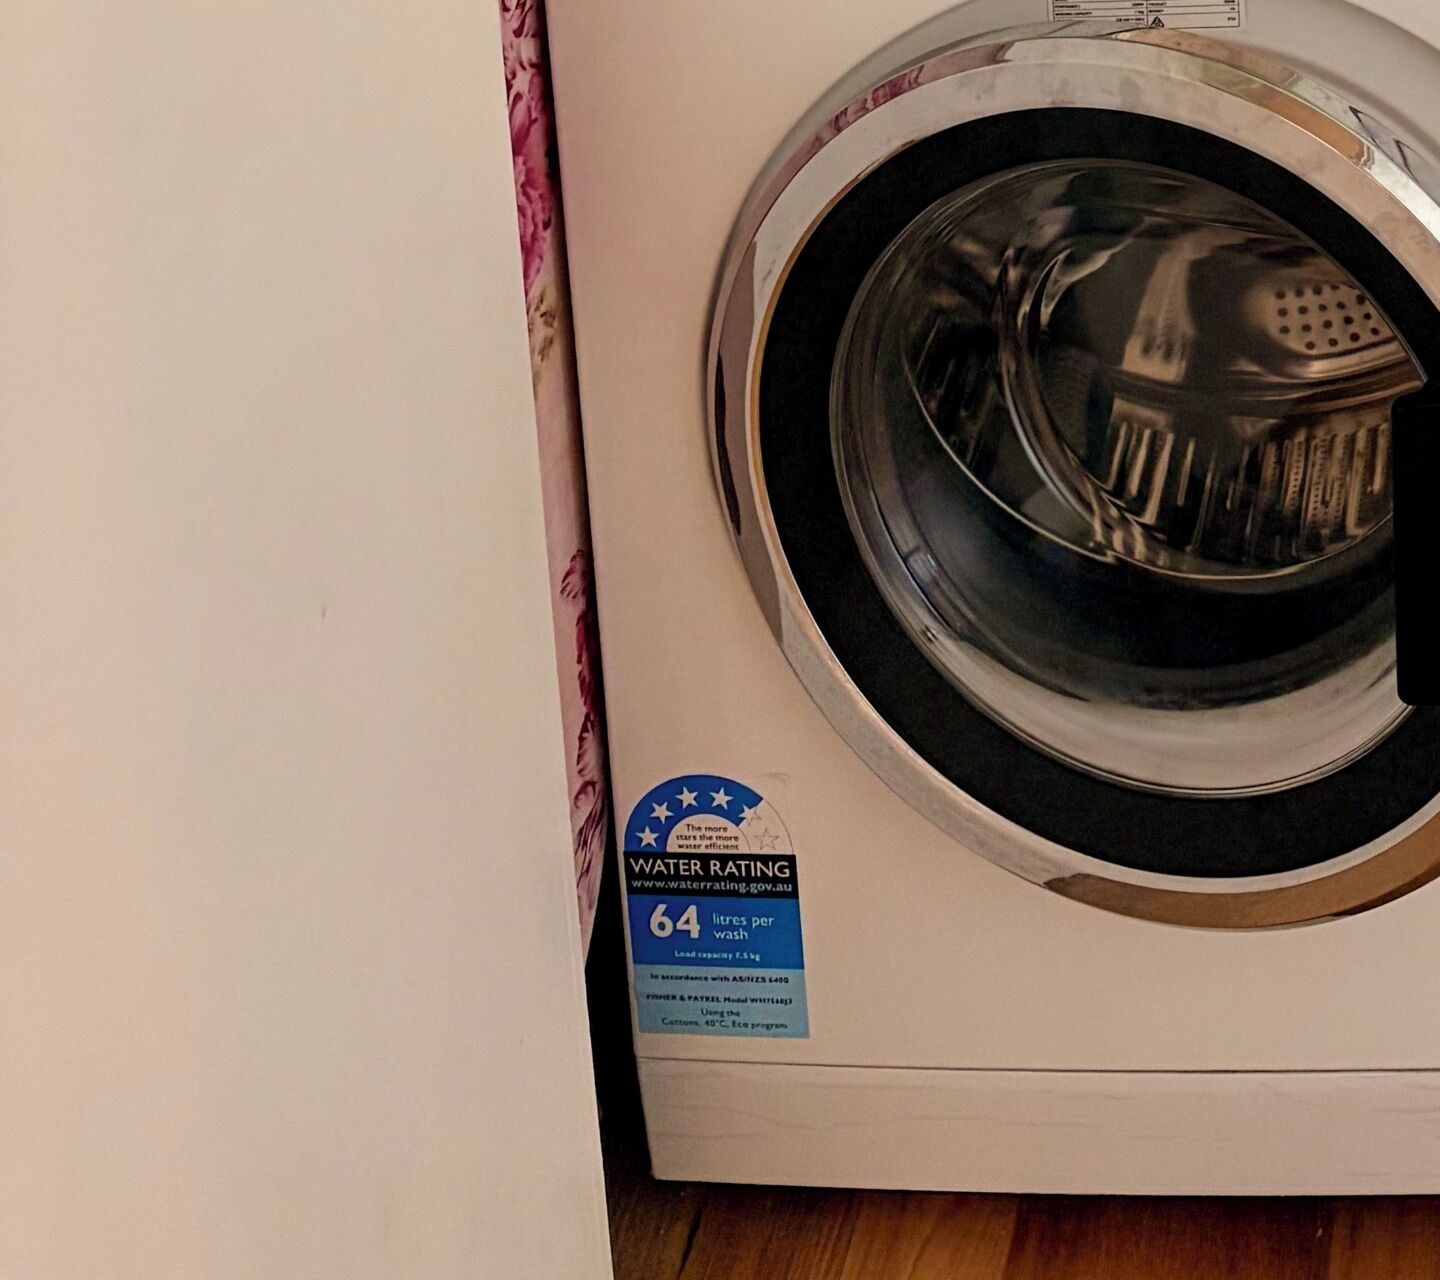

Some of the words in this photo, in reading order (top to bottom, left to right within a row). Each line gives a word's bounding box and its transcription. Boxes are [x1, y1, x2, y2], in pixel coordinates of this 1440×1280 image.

[686, 824, 702, 832] The
[705, 842, 739, 850] efficient
[630, 858, 704, 876] WATER
[710, 860, 790, 878] RATING
[631, 880, 792, 894] www.waterrating.gov.au
[650, 903, 700, 939] 64
[712, 913, 747, 926] litres
[752, 916, 775, 928] per
[713, 928, 748, 940] wash
